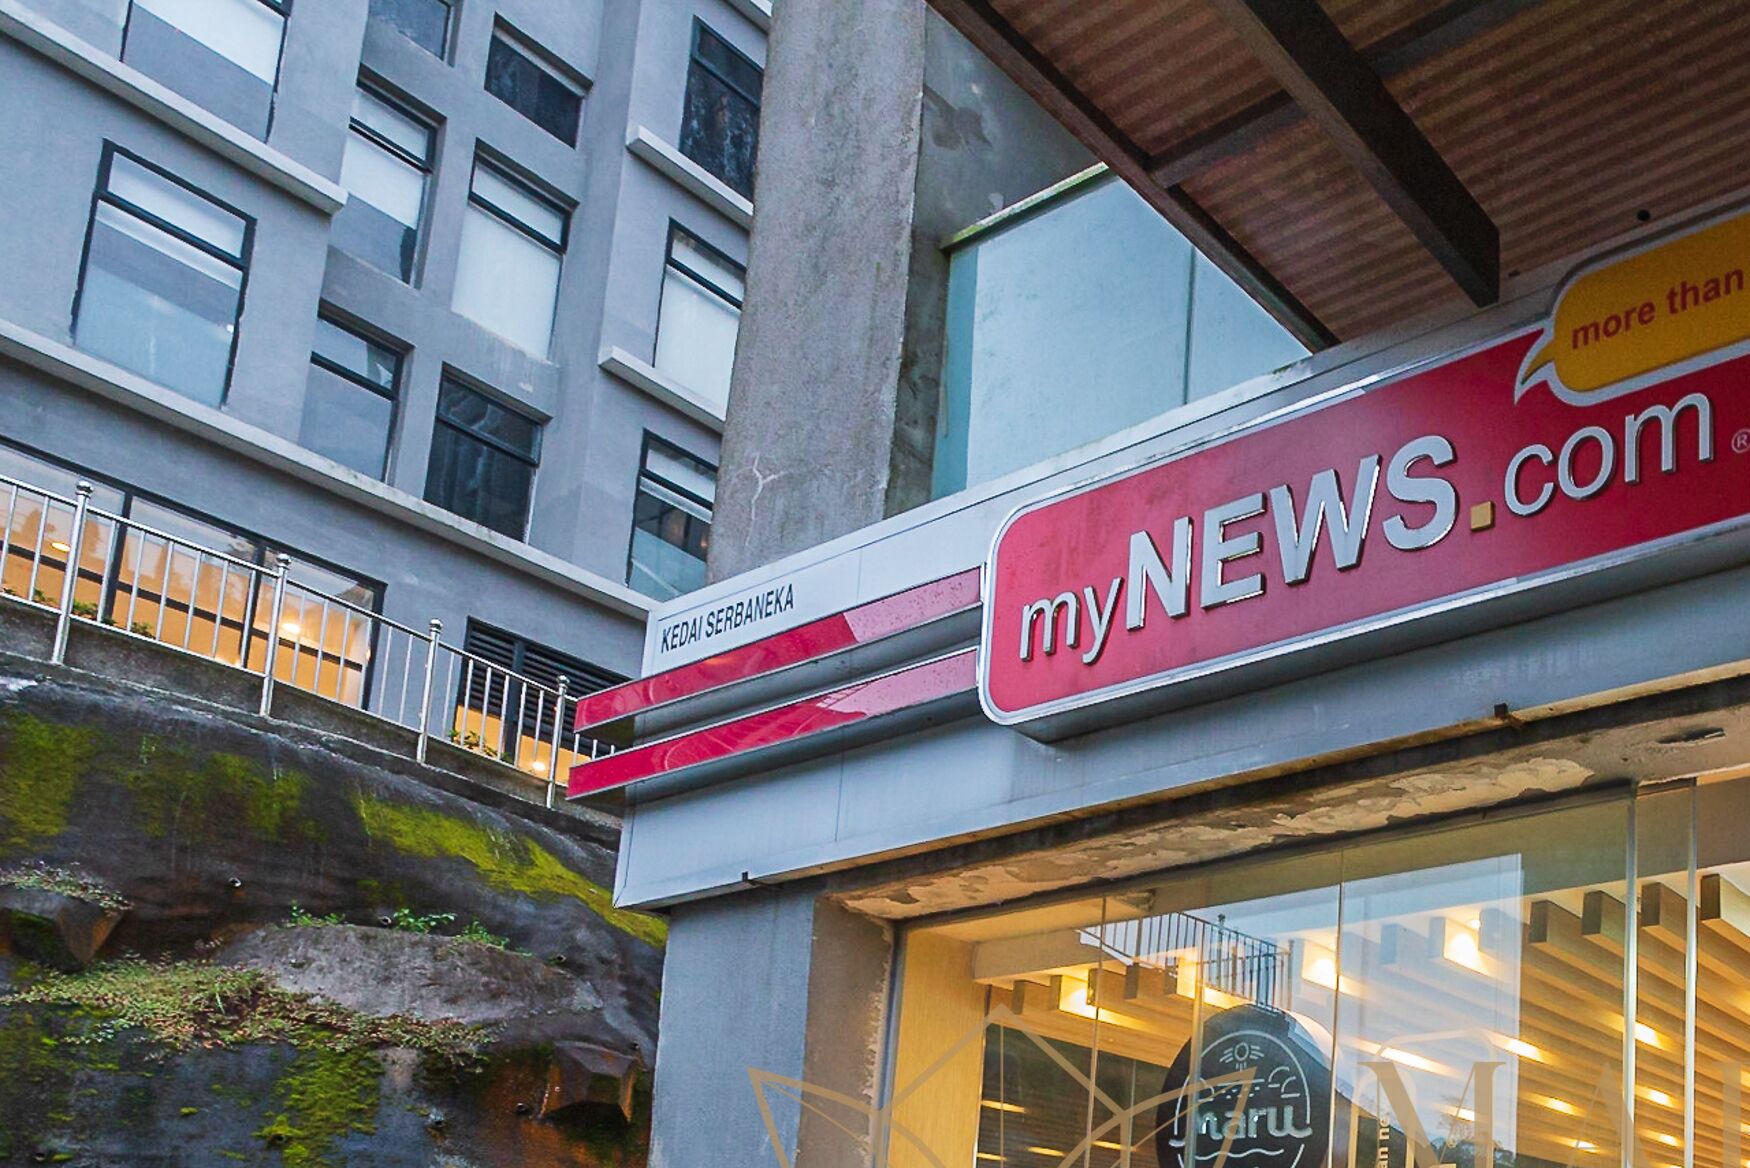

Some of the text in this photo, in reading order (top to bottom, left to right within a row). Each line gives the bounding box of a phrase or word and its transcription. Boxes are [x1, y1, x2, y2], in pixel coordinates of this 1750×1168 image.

[1569, 304, 1656, 352] more
[1667, 267, 1747, 318] than
[1019, 391, 1714, 667] myNEWS.com
[661, 583, 795, 654] KEDAI SERBANEKA
